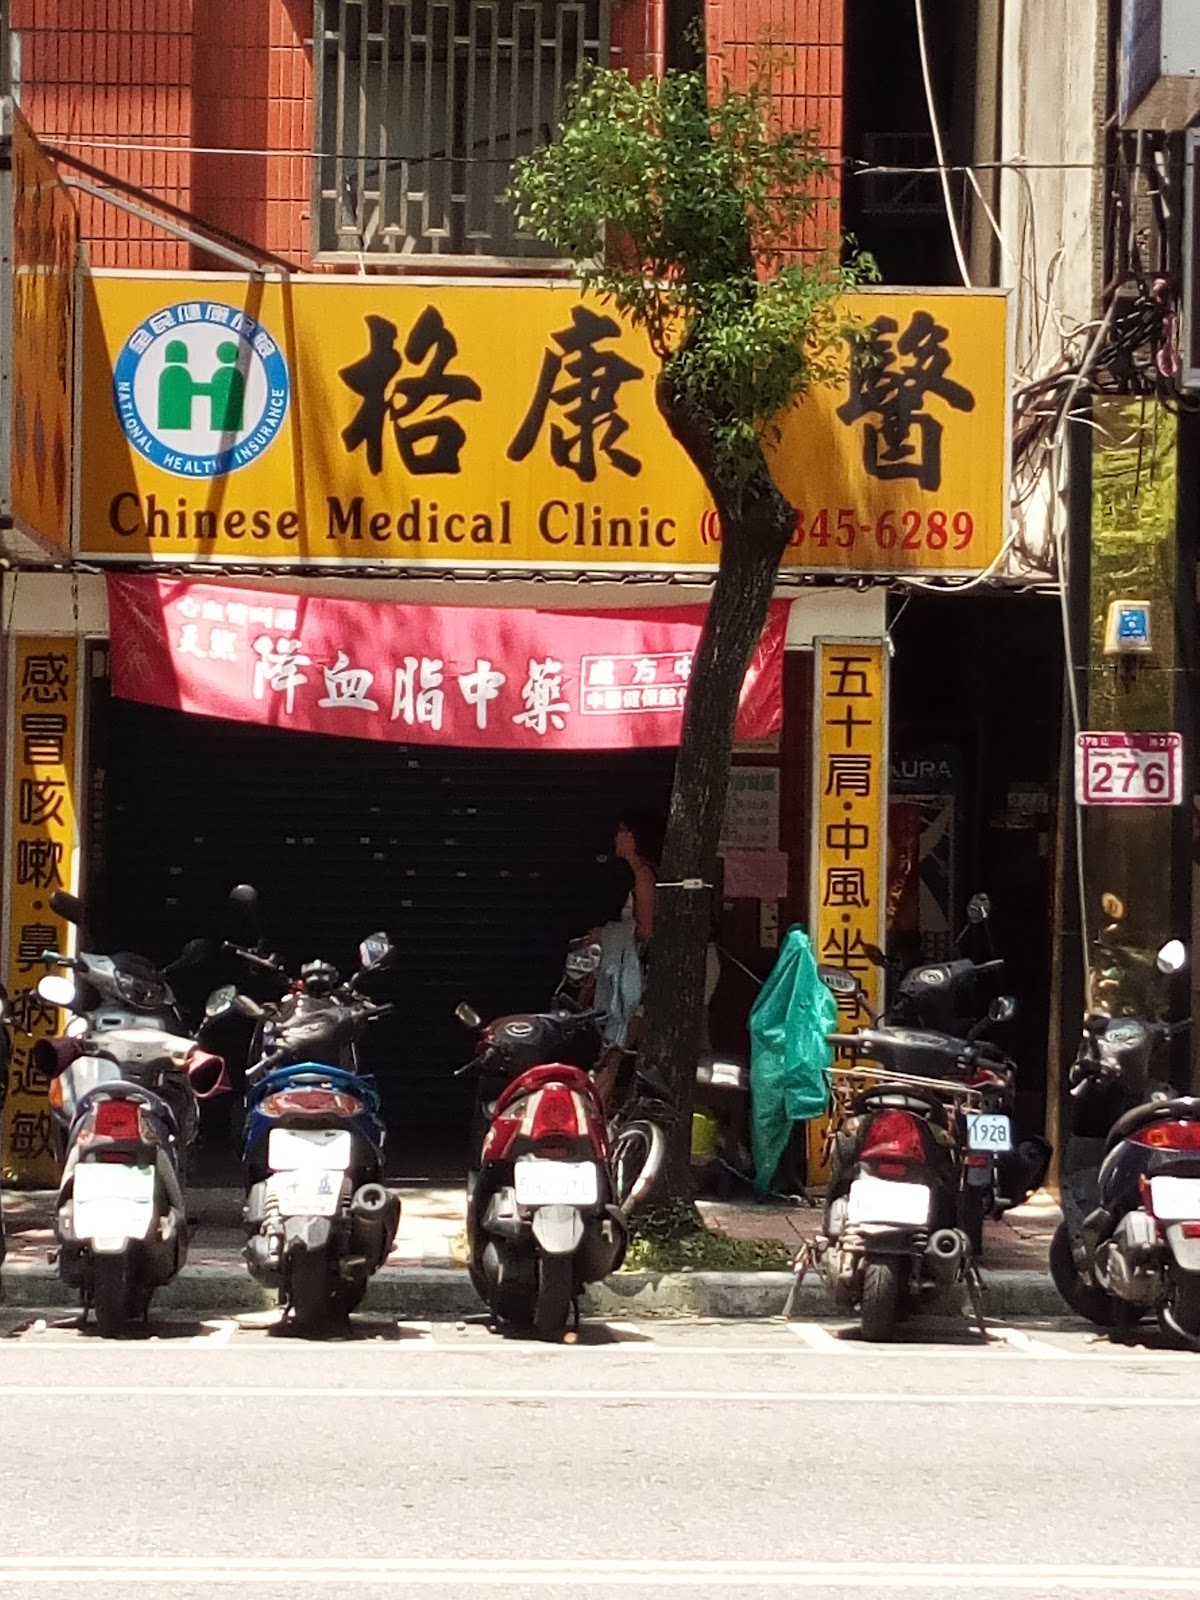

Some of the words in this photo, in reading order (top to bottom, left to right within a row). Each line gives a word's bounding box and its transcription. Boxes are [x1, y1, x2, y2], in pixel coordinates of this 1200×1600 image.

[117, 381, 152, 453] NATIONAL
[162, 453, 222, 474] HEALTH
[233, 388, 285, 464] INSURANCE
[108, 492, 300, 540] Chinese
[326, 495, 511, 545] Medical
[538, 500, 676, 548] Clinic
[252, 636, 572, 735] 降血脂中藥
[1092, 761, 1165, 794] 276
